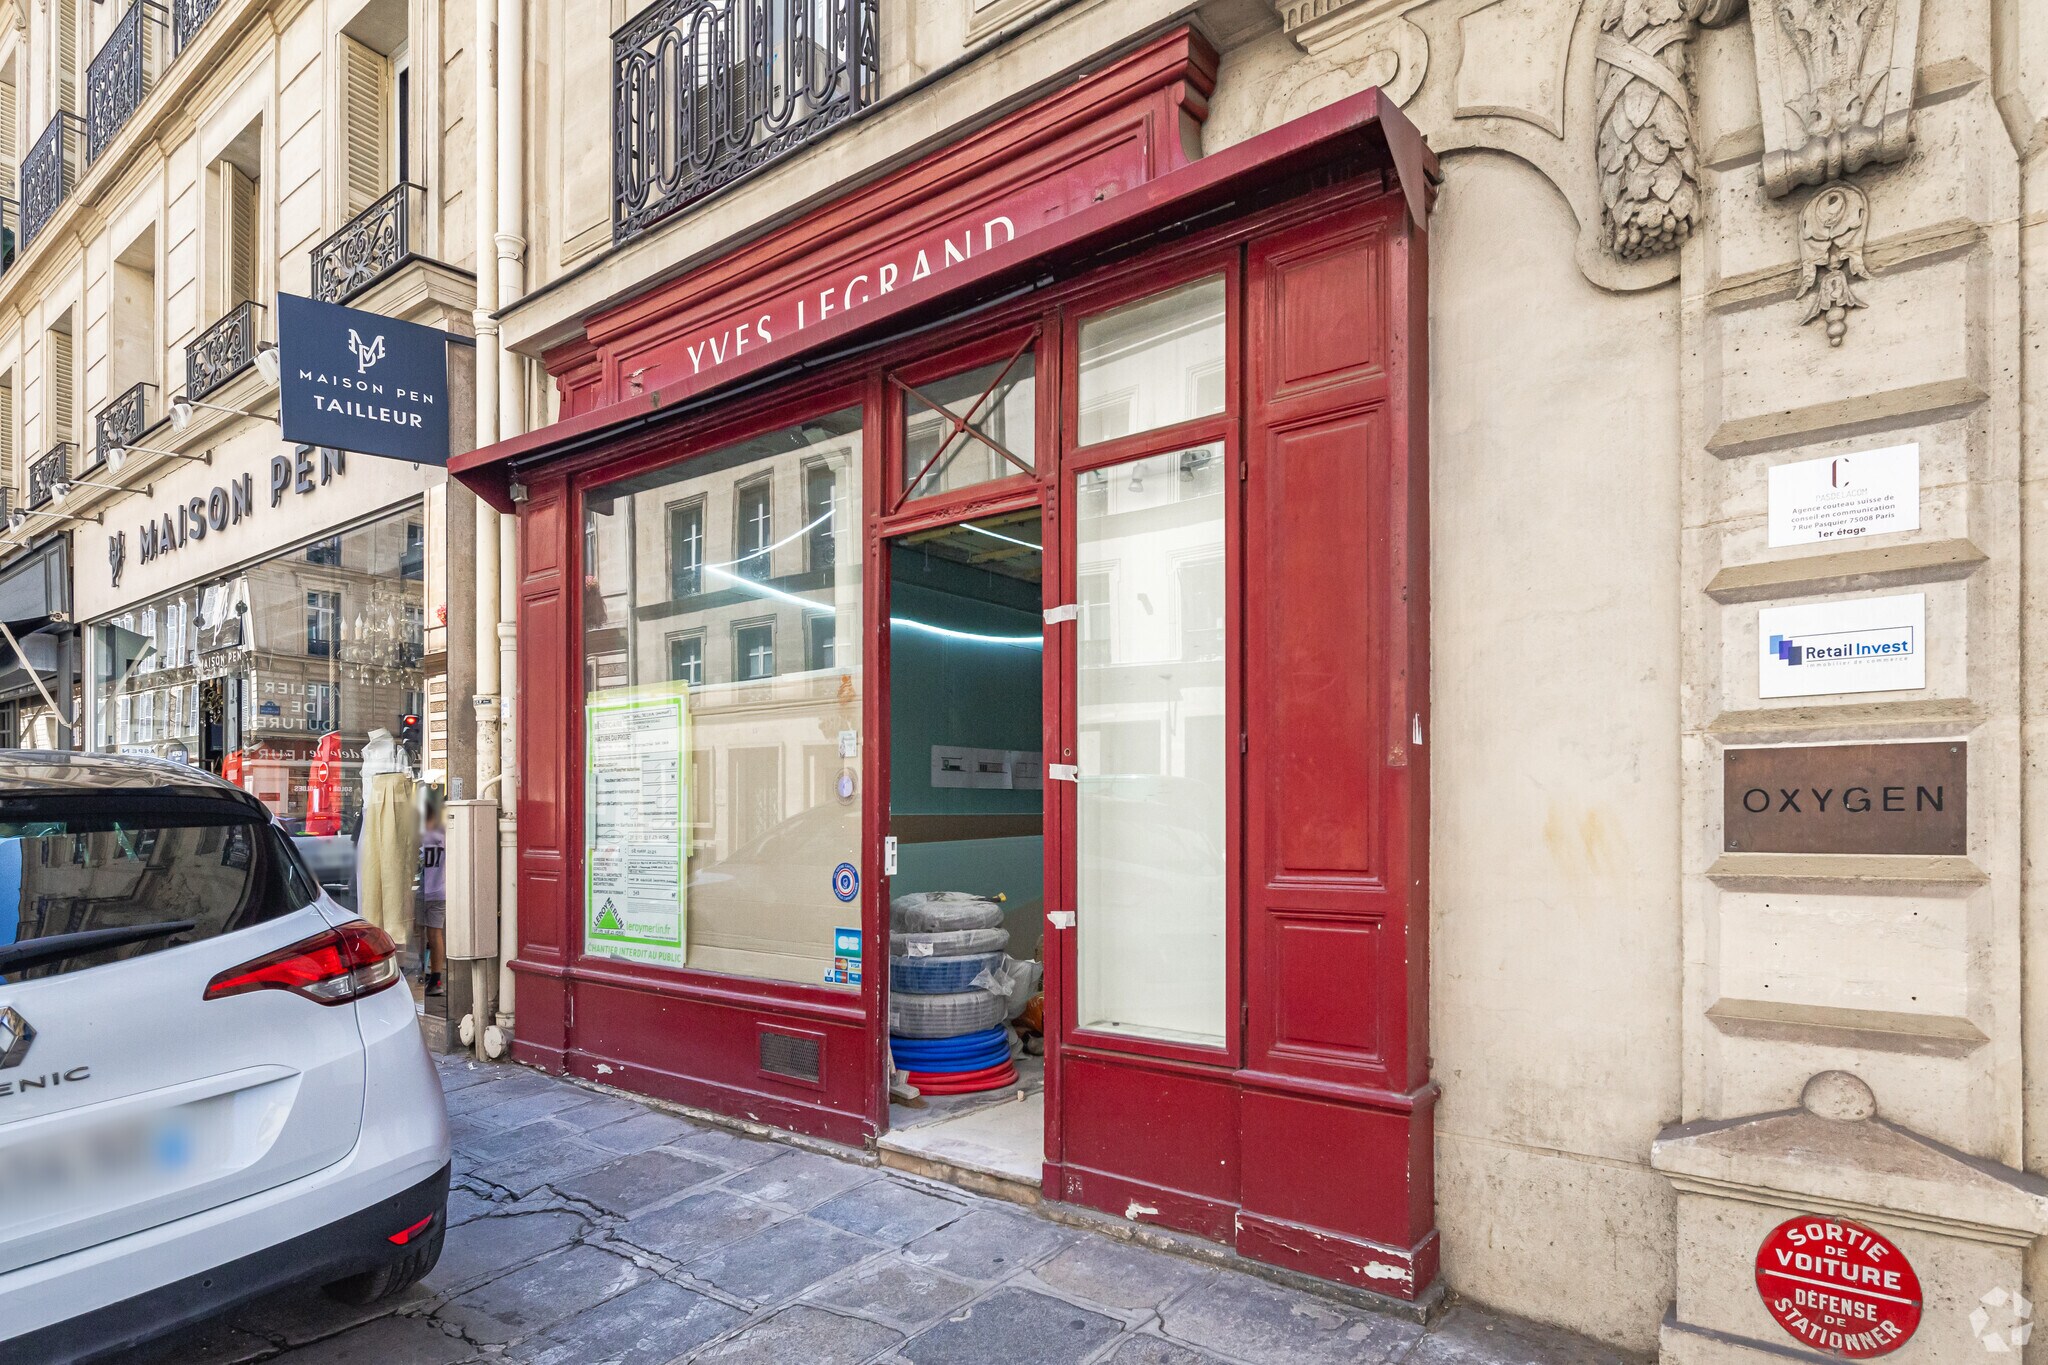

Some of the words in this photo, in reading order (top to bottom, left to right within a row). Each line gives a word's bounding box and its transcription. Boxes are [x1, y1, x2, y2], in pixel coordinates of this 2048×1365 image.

[686, 314, 772, 374] YVES
[299, 369, 383, 394] MAISON
[396, 388, 434, 404] PEN
[314, 395, 422, 428] TAILLEUR
[139, 472, 253, 565] MAISON
[270, 444, 346, 508] PEN
[1791, 513, 1819, 523] conseil
[1832, 503, 1896, 518] communication
[1792, 504, 1821, 515] Agence
[1822, 500, 1855, 510] couteau
[1857, 496, 1882, 506] suisse
[1884, 494, 1895, 502] de
[1798, 522, 1813, 530] Rue
[1814, 518, 1848, 529] Pasquier
[1850, 515, 1874, 524] 75008
[1875, 512, 1896, 520] Paris
[1818, 530, 1834, 538] 1er
[1836, 525, 1867, 538] étage
[228, 650, 242, 663] PEN
[1806, 644, 1852, 660] Retail
[1856, 640, 1908, 656] Invest
[1806, 660, 1851, 668] immobilier
[1866, 656, 1908, 664] commerce
[1742, 786, 1944, 813] OXYGEN
[593, 904, 608, 926] LEROY
[606, 897, 625, 929] MERLIN
[626, 920, 671, 935] leroymerlin.fr
[588, 942, 618, 954] CHANTIER
[619, 946, 648, 958] INTERDIT
[648, 950, 658, 959] AU
[658, 951, 681, 962] PUBLIC
[0, 1066, 90, 1098] ENIC
[1786, 1223, 1890, 1262] SORTIE
[1825, 1246, 1848, 1258] DE
[1776, 1248, 1902, 1290] VOITURE
[1774, 1297, 1902, 1352] STATIONNER
[1824, 1315, 1846, 1328] DE
